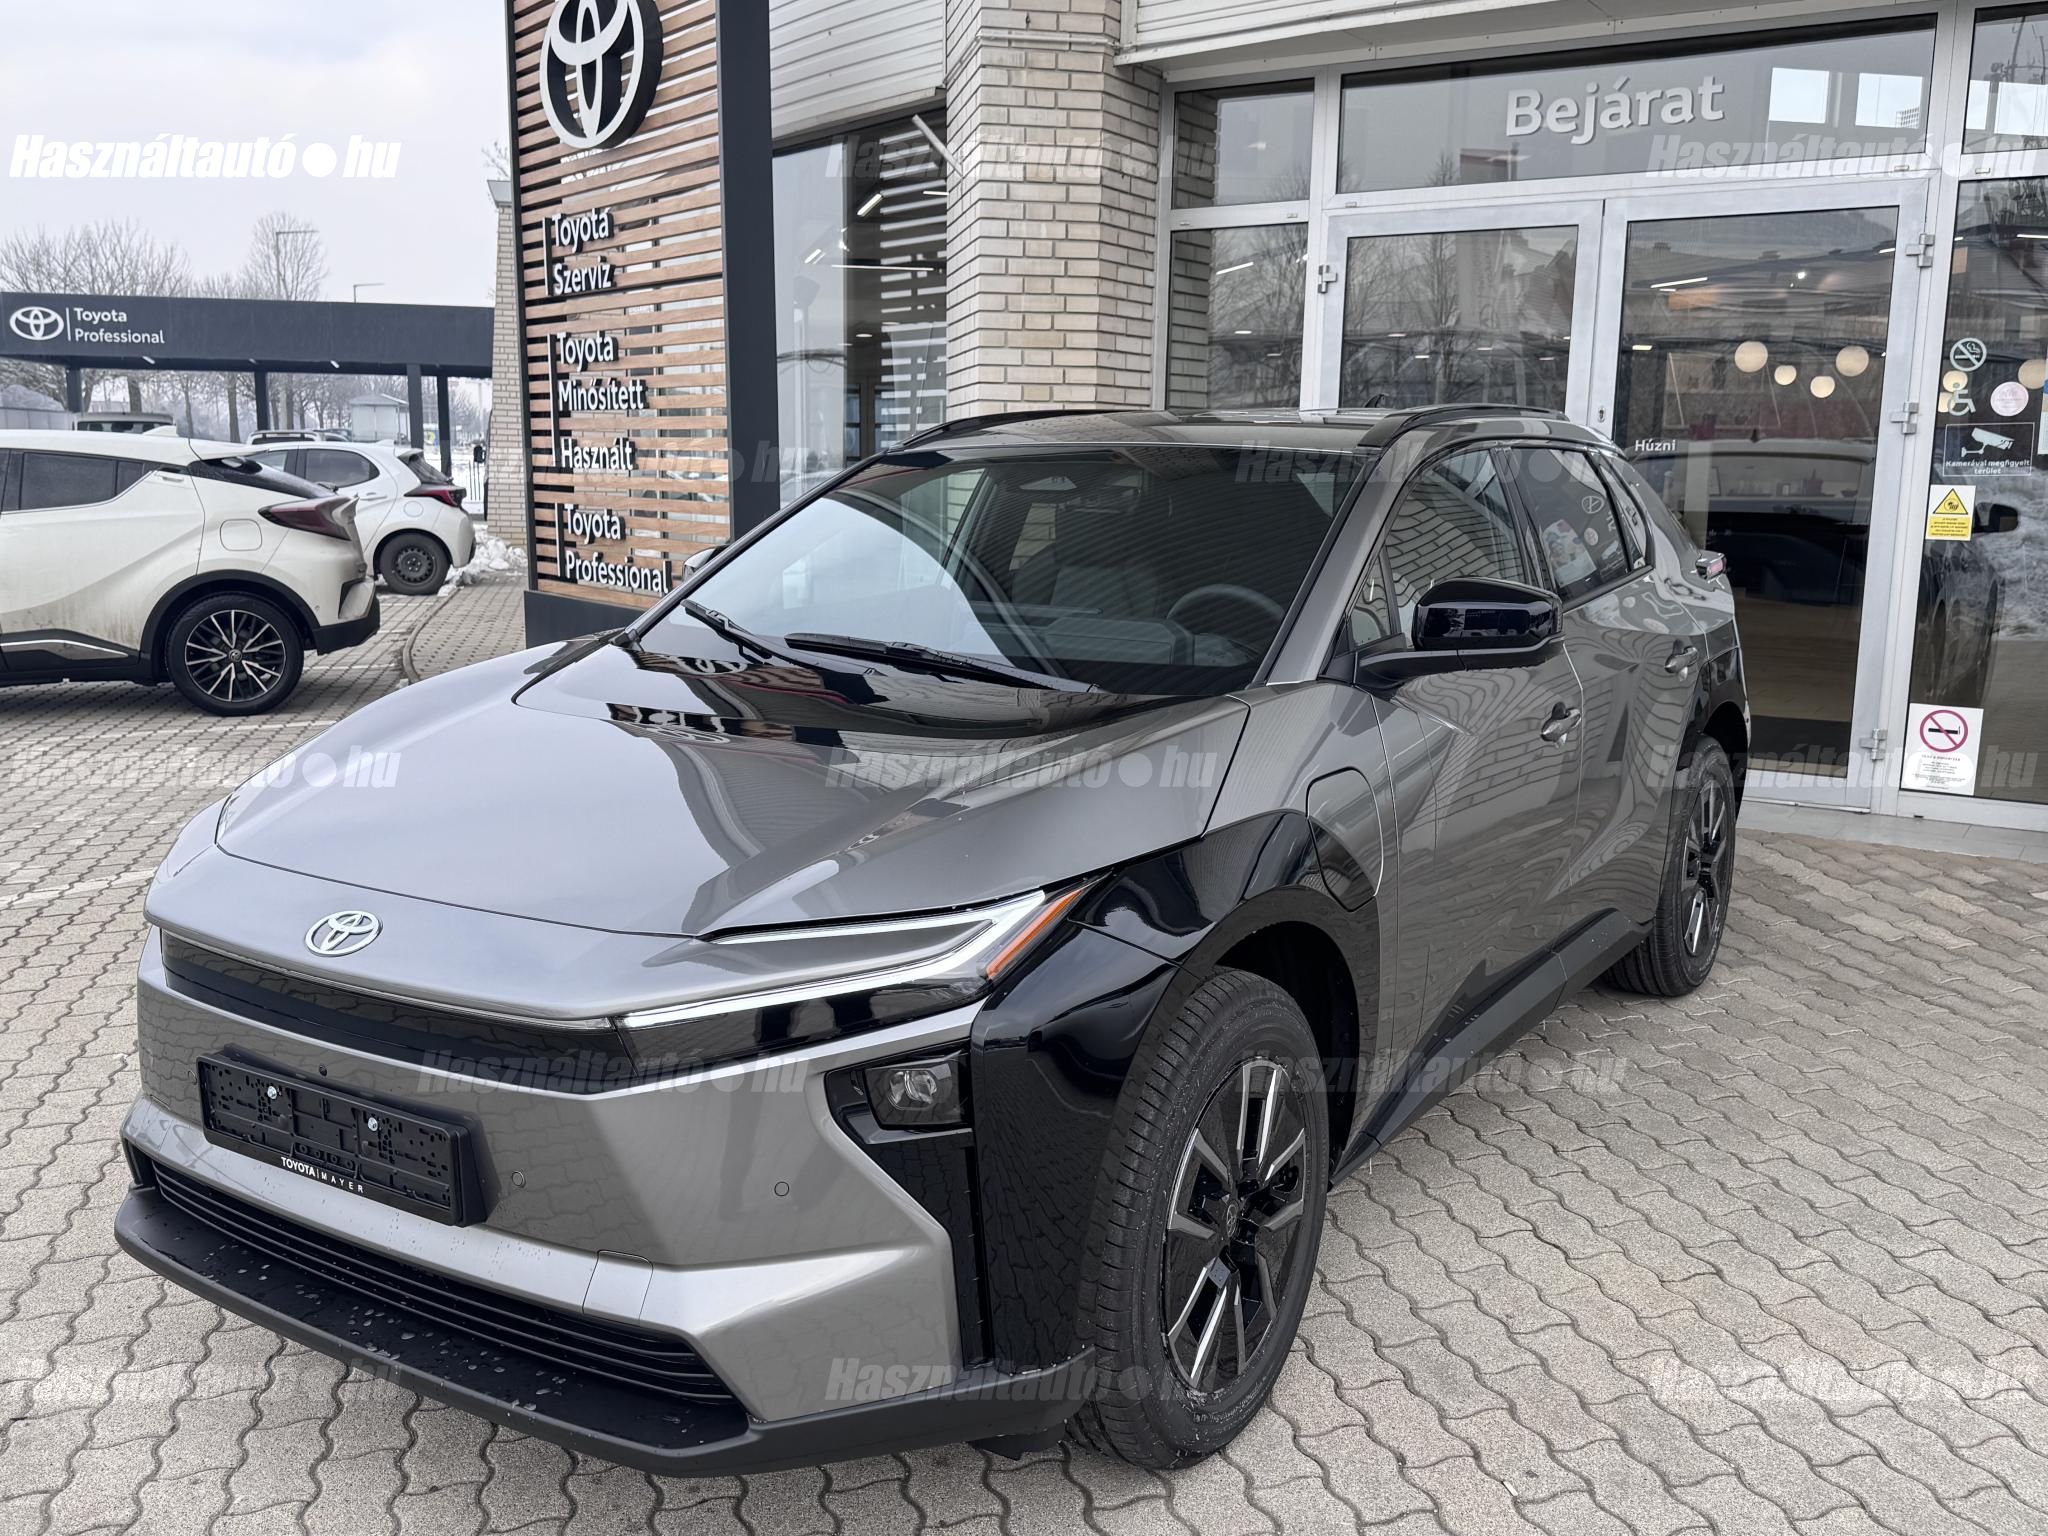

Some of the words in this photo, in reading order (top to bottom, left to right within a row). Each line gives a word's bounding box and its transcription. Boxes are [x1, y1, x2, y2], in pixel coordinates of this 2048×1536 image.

[1506, 75, 1726, 145] Bejárat
[551, 209, 611, 252] Toyota
[554, 258, 612, 295] Szerviz
[74, 307, 128, 327] Toyota
[74, 328, 165, 345] Professional
[557, 332, 615, 372] Toyota
[558, 380, 645, 411] Minősített
[561, 438, 634, 471] Használt
[1635, 439, 1676, 453] Húzni
[564, 504, 622, 545] Toyota
[565, 550, 671, 594] Professional
[281, 1156, 315, 1177] TOYOTA
[321, 1171, 364, 1193] MAYER
